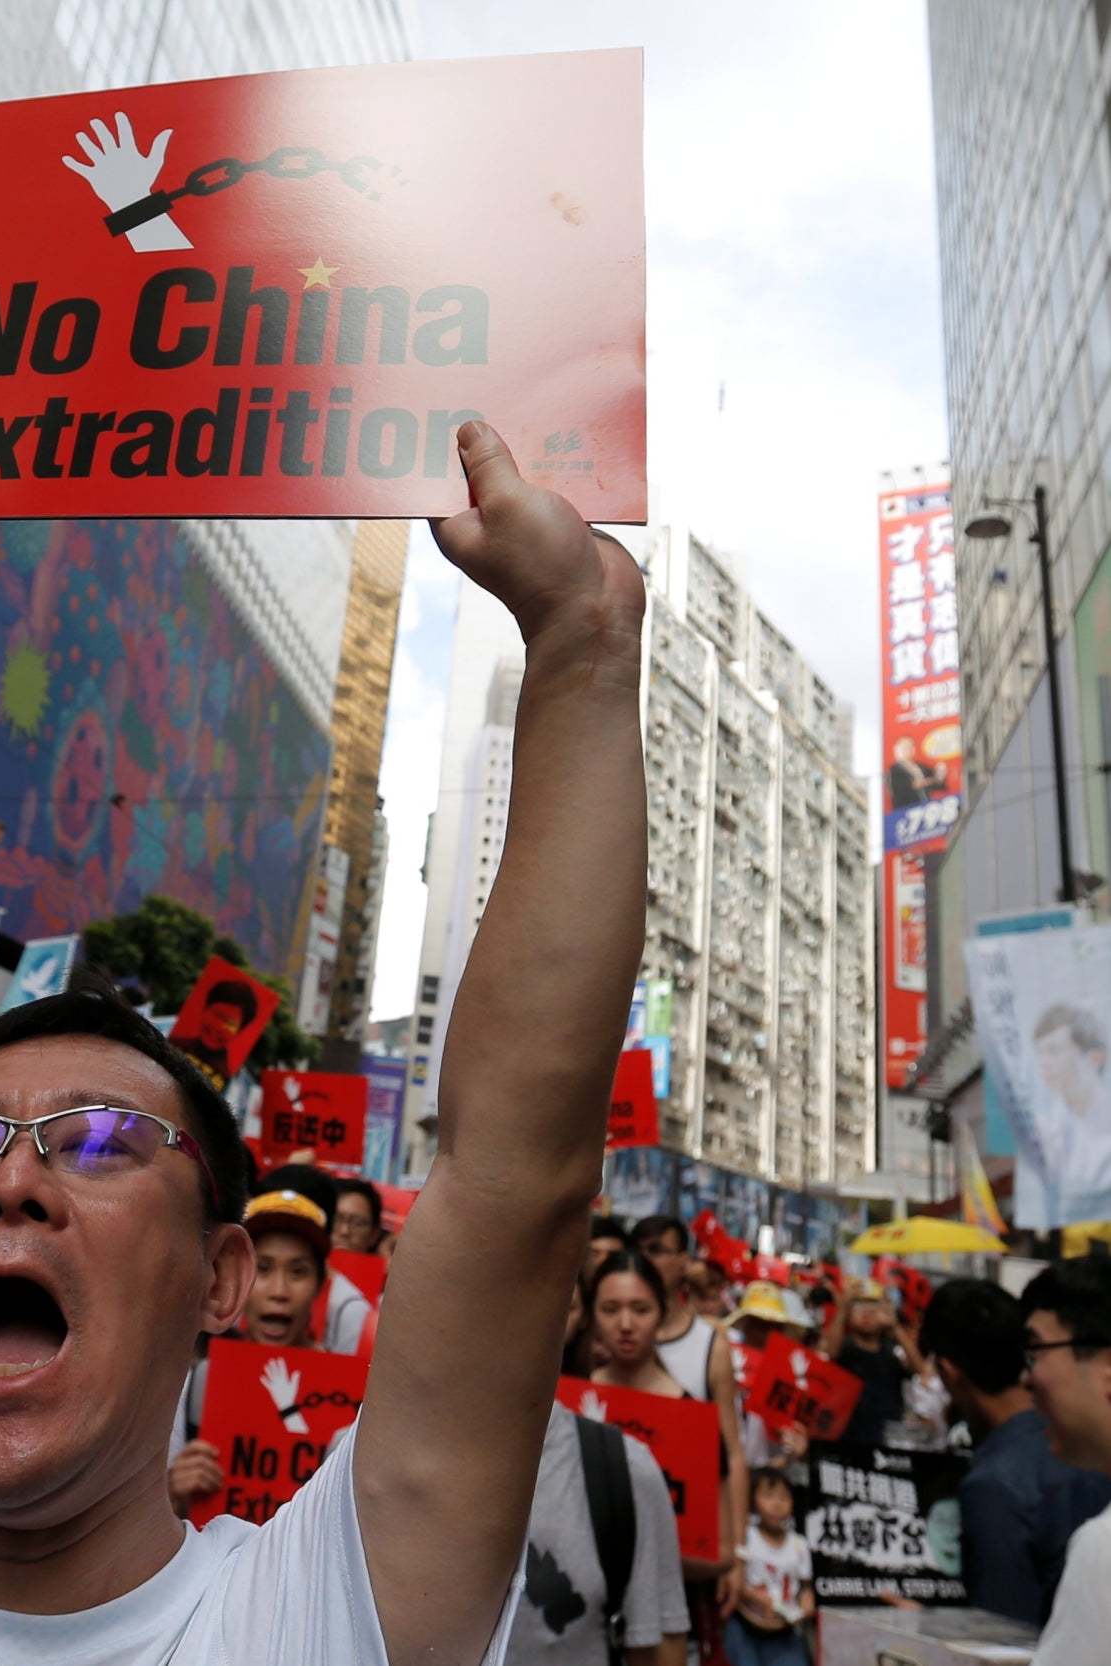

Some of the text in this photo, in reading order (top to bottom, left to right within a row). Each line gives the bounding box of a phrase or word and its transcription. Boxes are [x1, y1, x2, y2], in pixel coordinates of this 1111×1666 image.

[129, 266, 490, 369] China
[274, 1112, 346, 1146] 反送中
[230, 1436, 278, 1479] No
[225, 1488, 281, 1526] Ext
